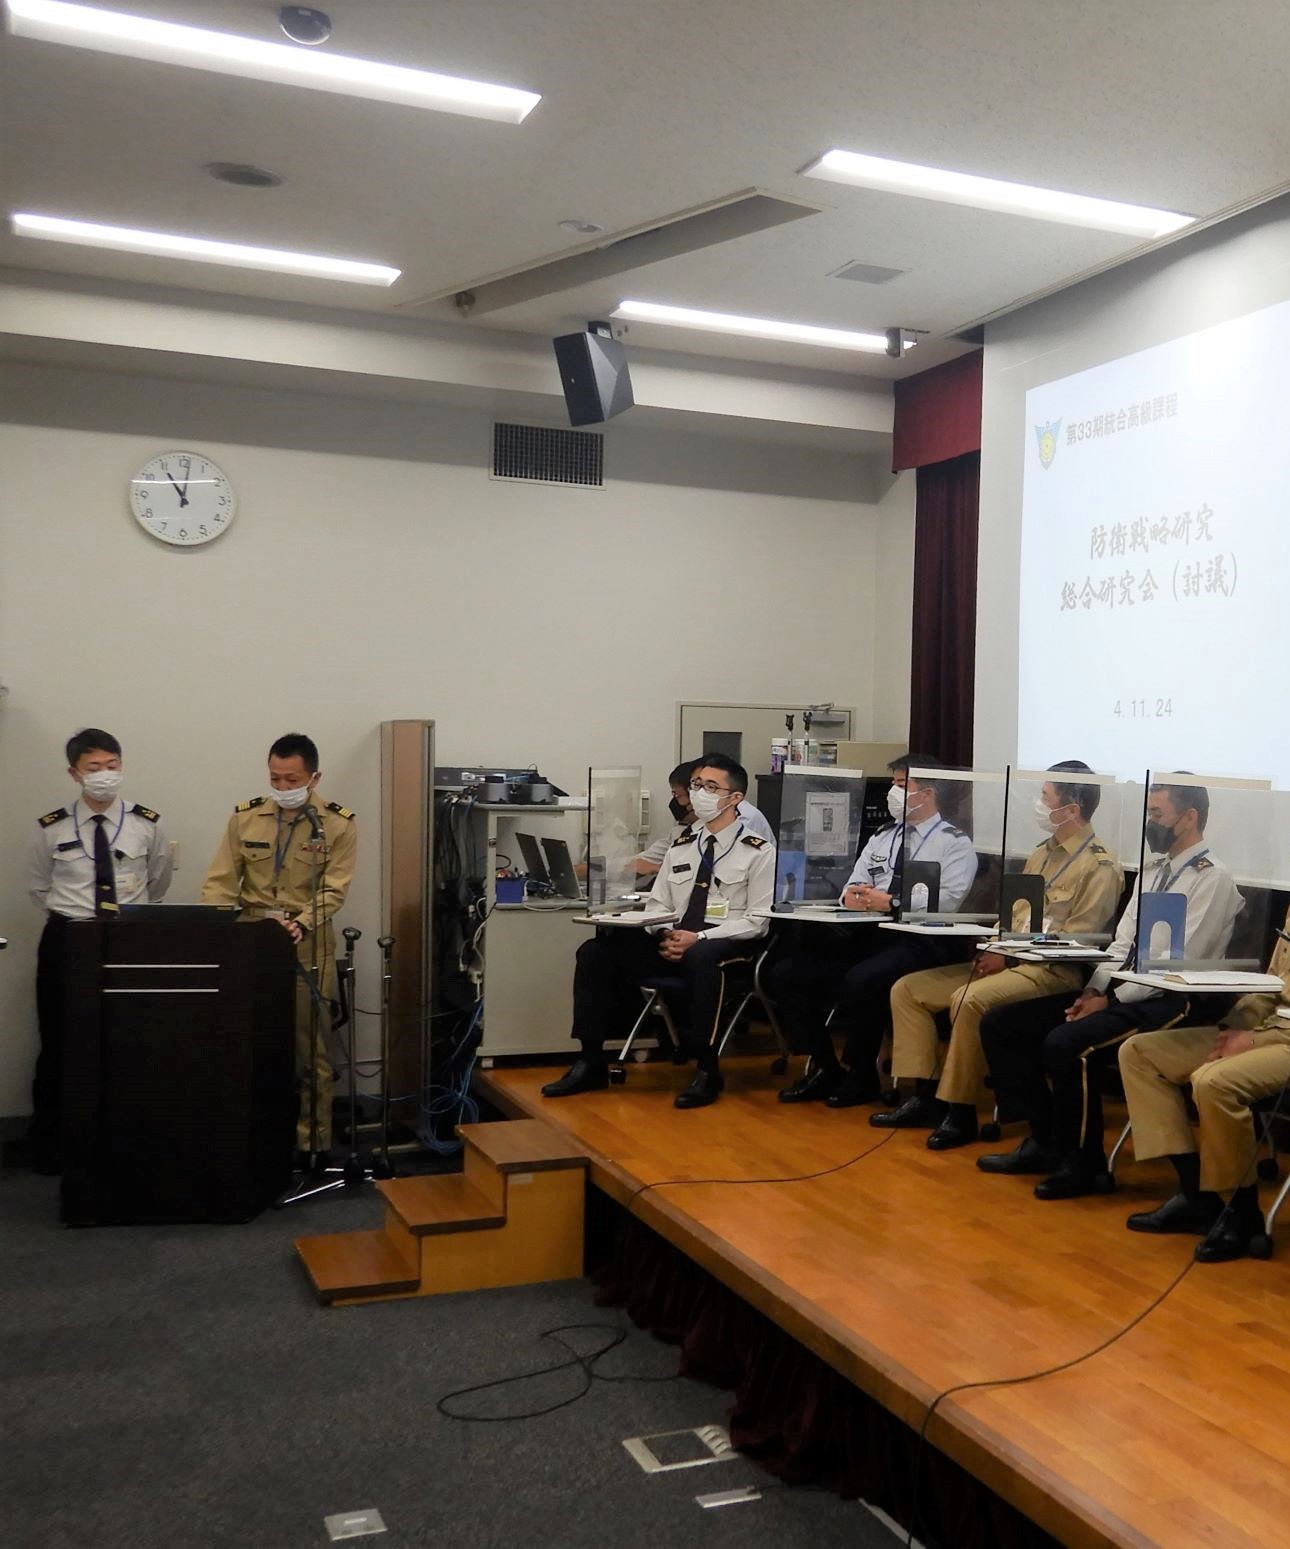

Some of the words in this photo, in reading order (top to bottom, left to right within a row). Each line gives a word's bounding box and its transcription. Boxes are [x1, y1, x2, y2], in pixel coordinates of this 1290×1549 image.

[1066, 392, 1178, 446] 第33期統合高級課程
[1090, 503, 1214, 560] 防衛戦略研究
